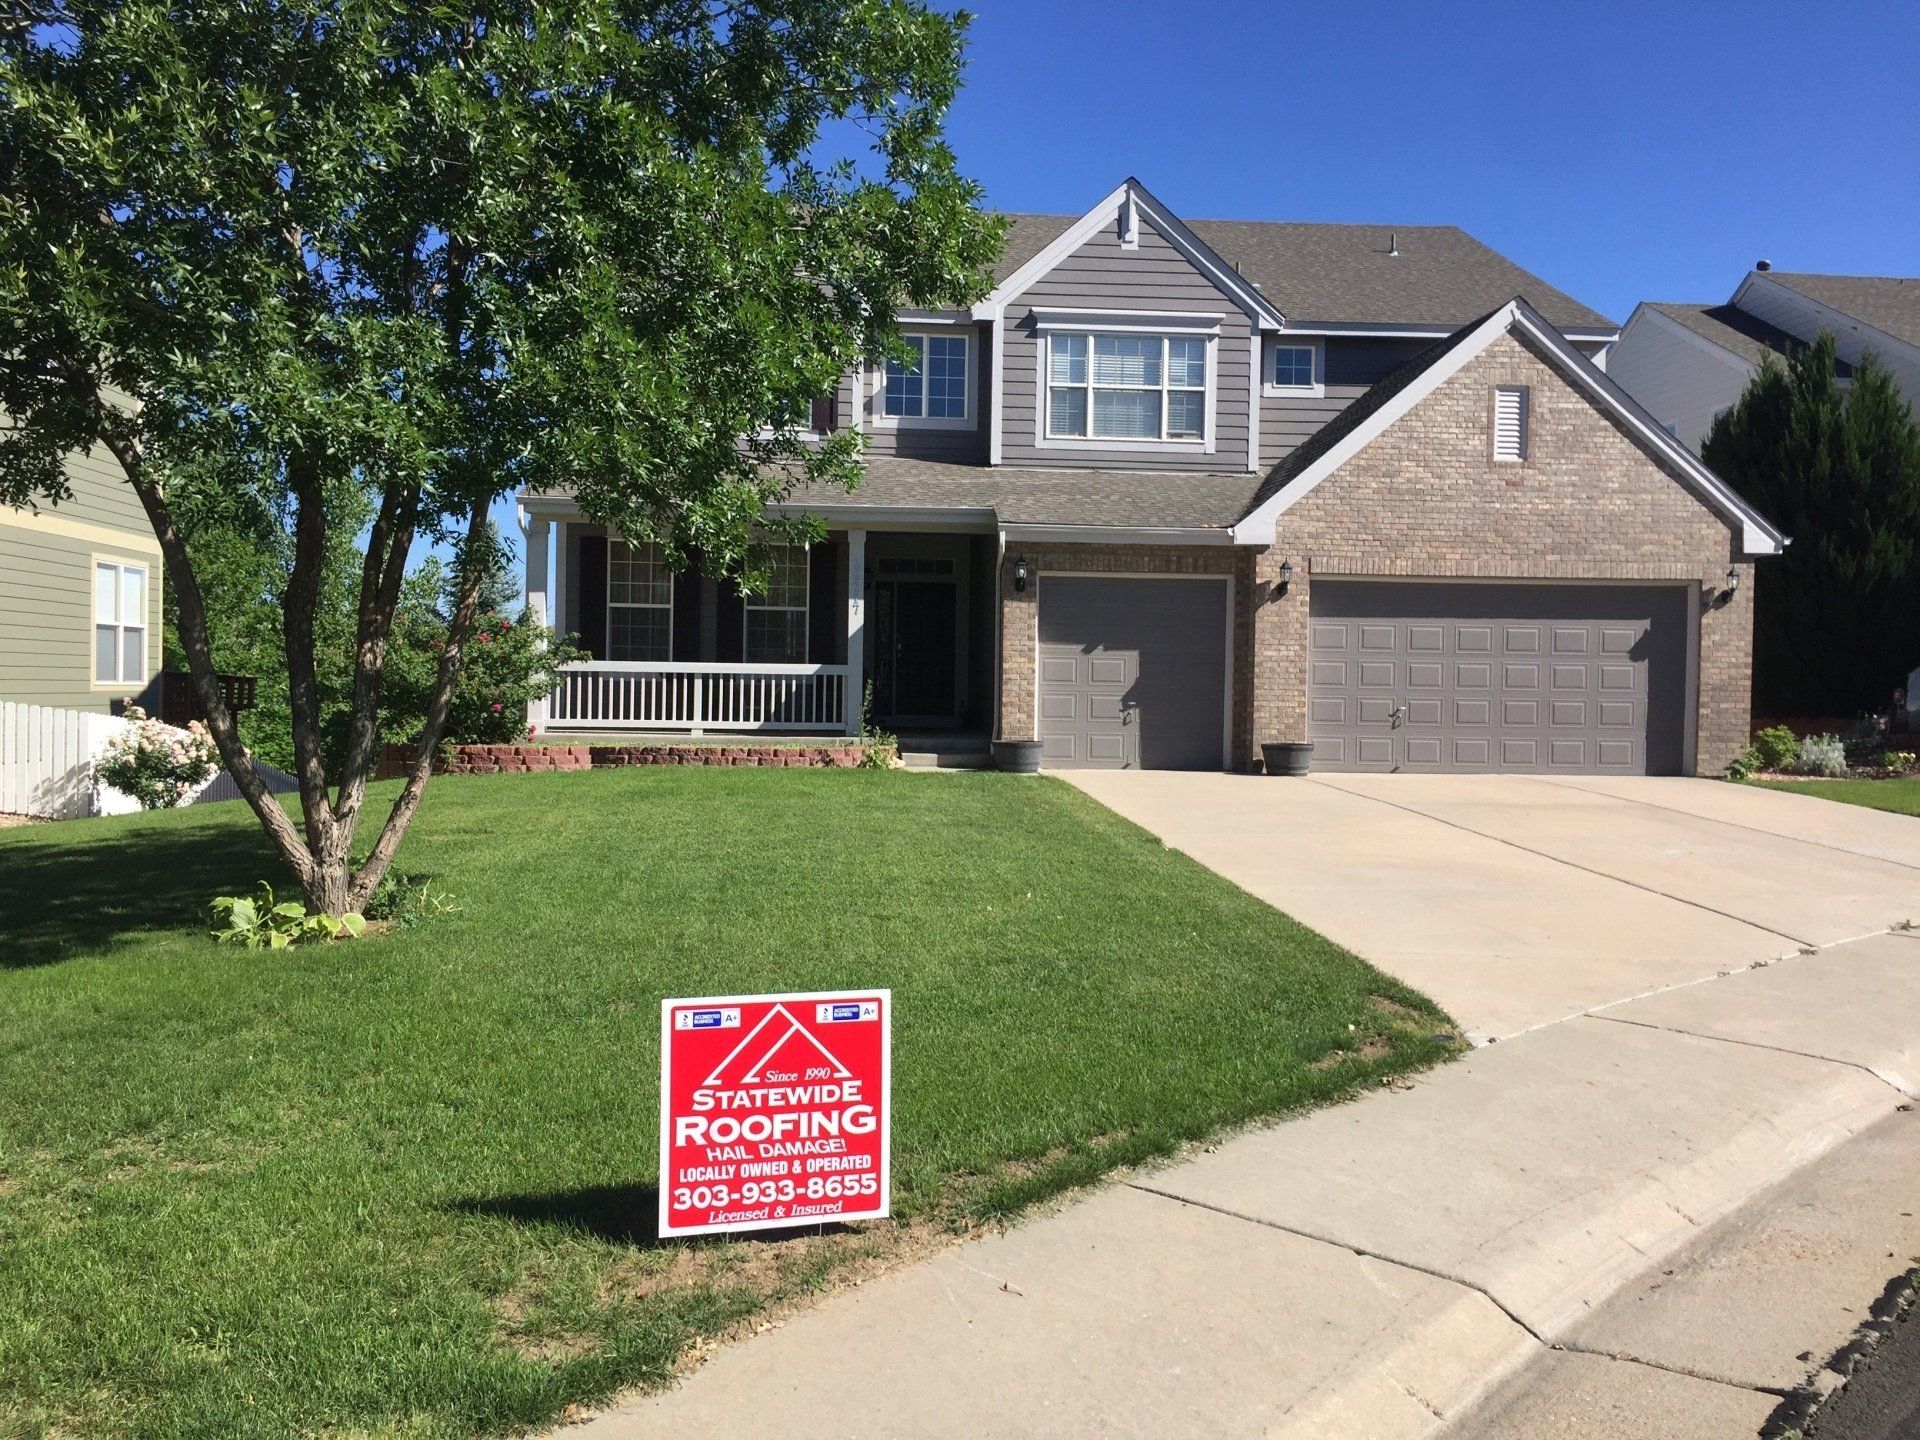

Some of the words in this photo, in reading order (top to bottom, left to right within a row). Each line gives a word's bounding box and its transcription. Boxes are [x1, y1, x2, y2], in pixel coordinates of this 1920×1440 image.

[725, 1014, 738, 1023] A+
[863, 1007, 876, 1016] A+
[765, 1070, 798, 1083] Since
[804, 1067, 830, 1081] 1990
[692, 1080, 862, 1110] STATEWIDE
[675, 1105, 877, 1147] ROOFING
[706, 1147, 754, 1162] HAIL
[759, 1138, 847, 1158] DAMAGE!
[679, 1164, 736, 1183] LOCALLY
[740, 1160, 788, 1178] OWNED
[791, 1159, 802, 1174] &
[806, 1154, 872, 1172] OPERATED
[672, 1172, 878, 1211] 303-933-8655
[708, 1207, 769, 1224] Licensed
[774, 1205, 786, 1218] &
[791, 1201, 843, 1216] Insured
